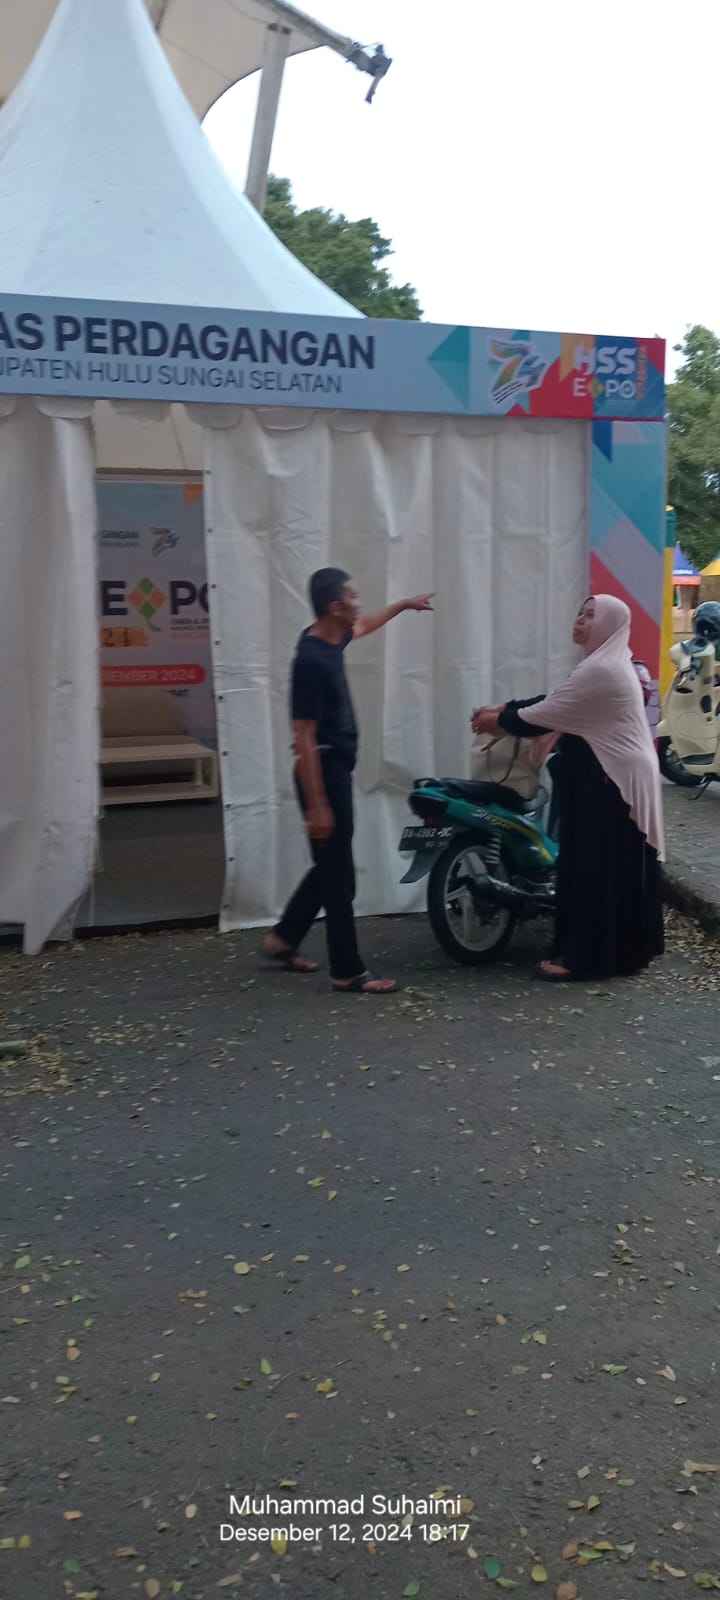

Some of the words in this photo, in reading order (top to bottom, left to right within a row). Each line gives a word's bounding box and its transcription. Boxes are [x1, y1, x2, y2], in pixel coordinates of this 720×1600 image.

[54, 315, 375, 371] PERDAGANGAN
[572, 340, 637, 376] HSS
[88, 361, 153, 384] HULU
[158, 365, 244, 390] SUNGAI
[248, 370, 343, 393] SELATAN
